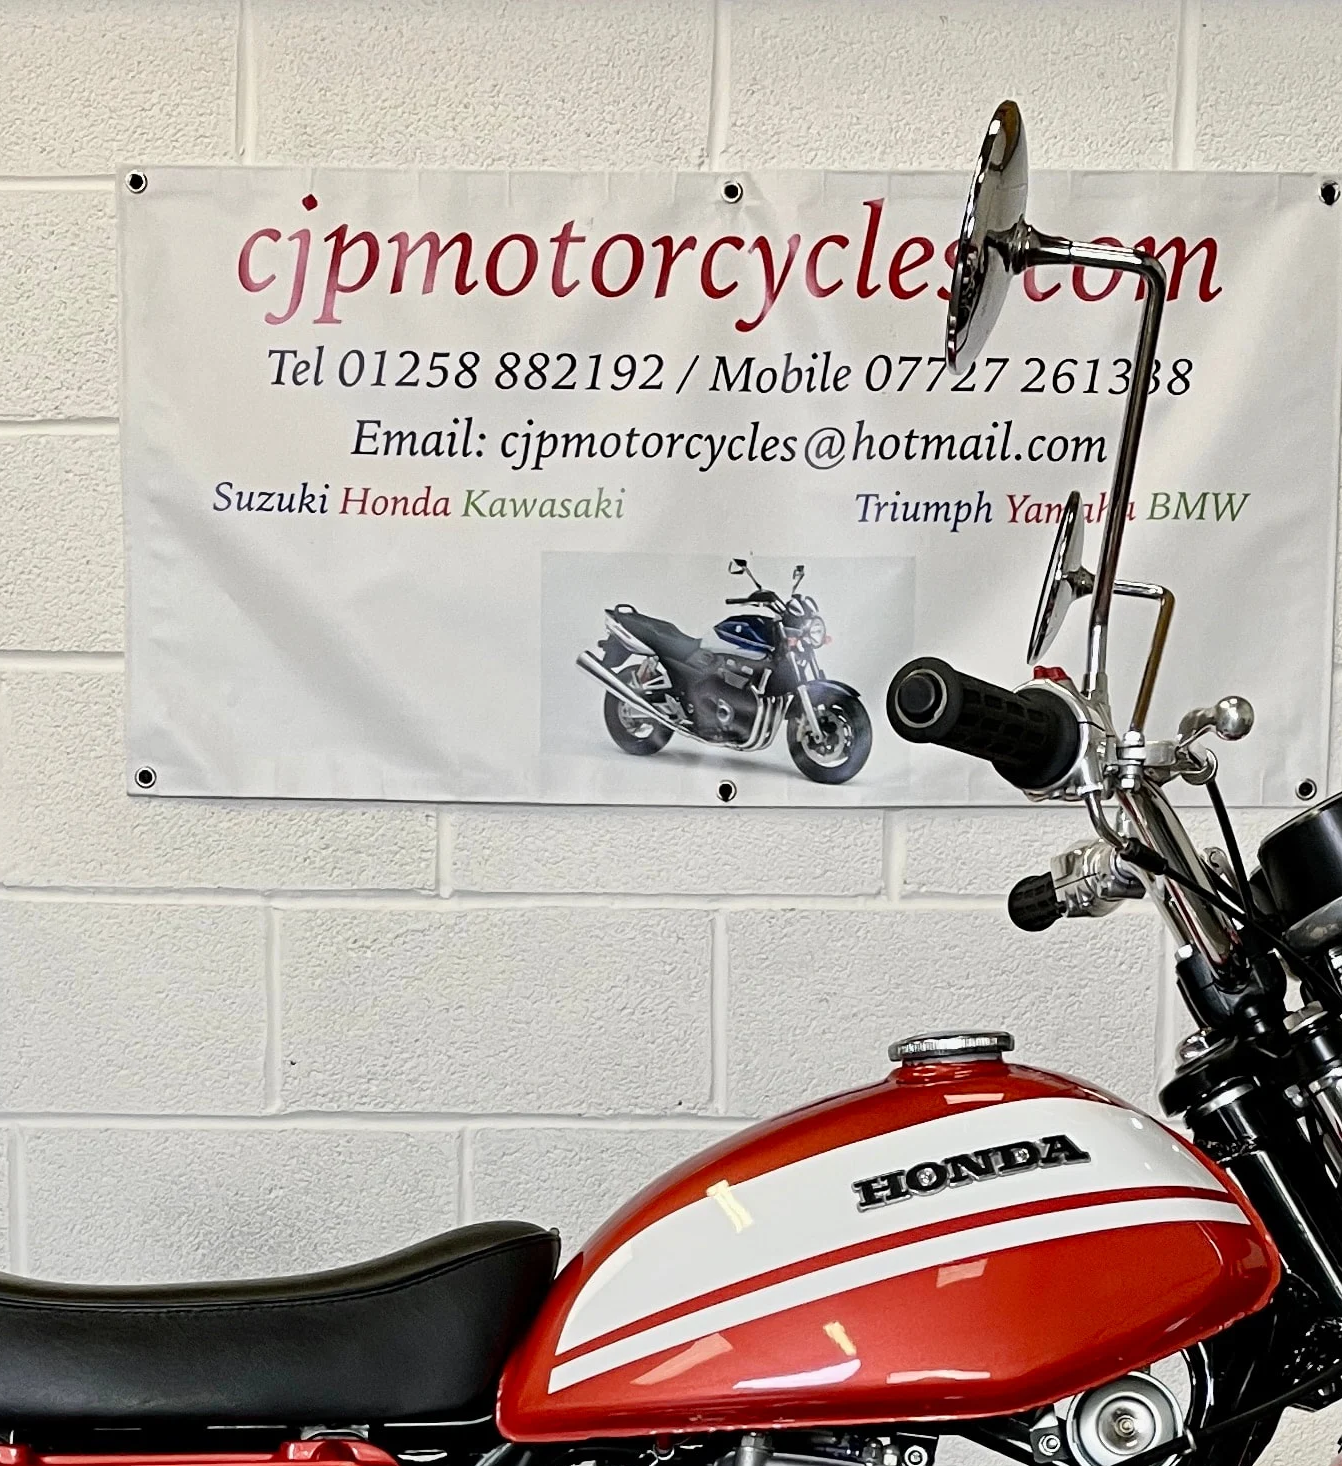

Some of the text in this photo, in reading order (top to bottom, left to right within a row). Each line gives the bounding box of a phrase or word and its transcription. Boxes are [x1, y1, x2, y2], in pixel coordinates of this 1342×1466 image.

[238, 194, 1222, 332] cjpmotorcyclecom
[267, 346, 323, 387] Tel
[337, 348, 480, 389] 01258
[494, 351, 664, 391] 882192
[675, 354, 699, 395] /
[708, 352, 852, 393] Mobile
[865, 354, 1009, 394] 07727
[351, 417, 1107, 471] Email: cjpmotorcycles@hotmail.com
[213, 481, 625, 519] Suzuki Honda Kawasaki
[855, 491, 993, 532] Triumph
[1148, 491, 1250, 522] BMW
[851, 1134, 1090, 1212] HONDA
